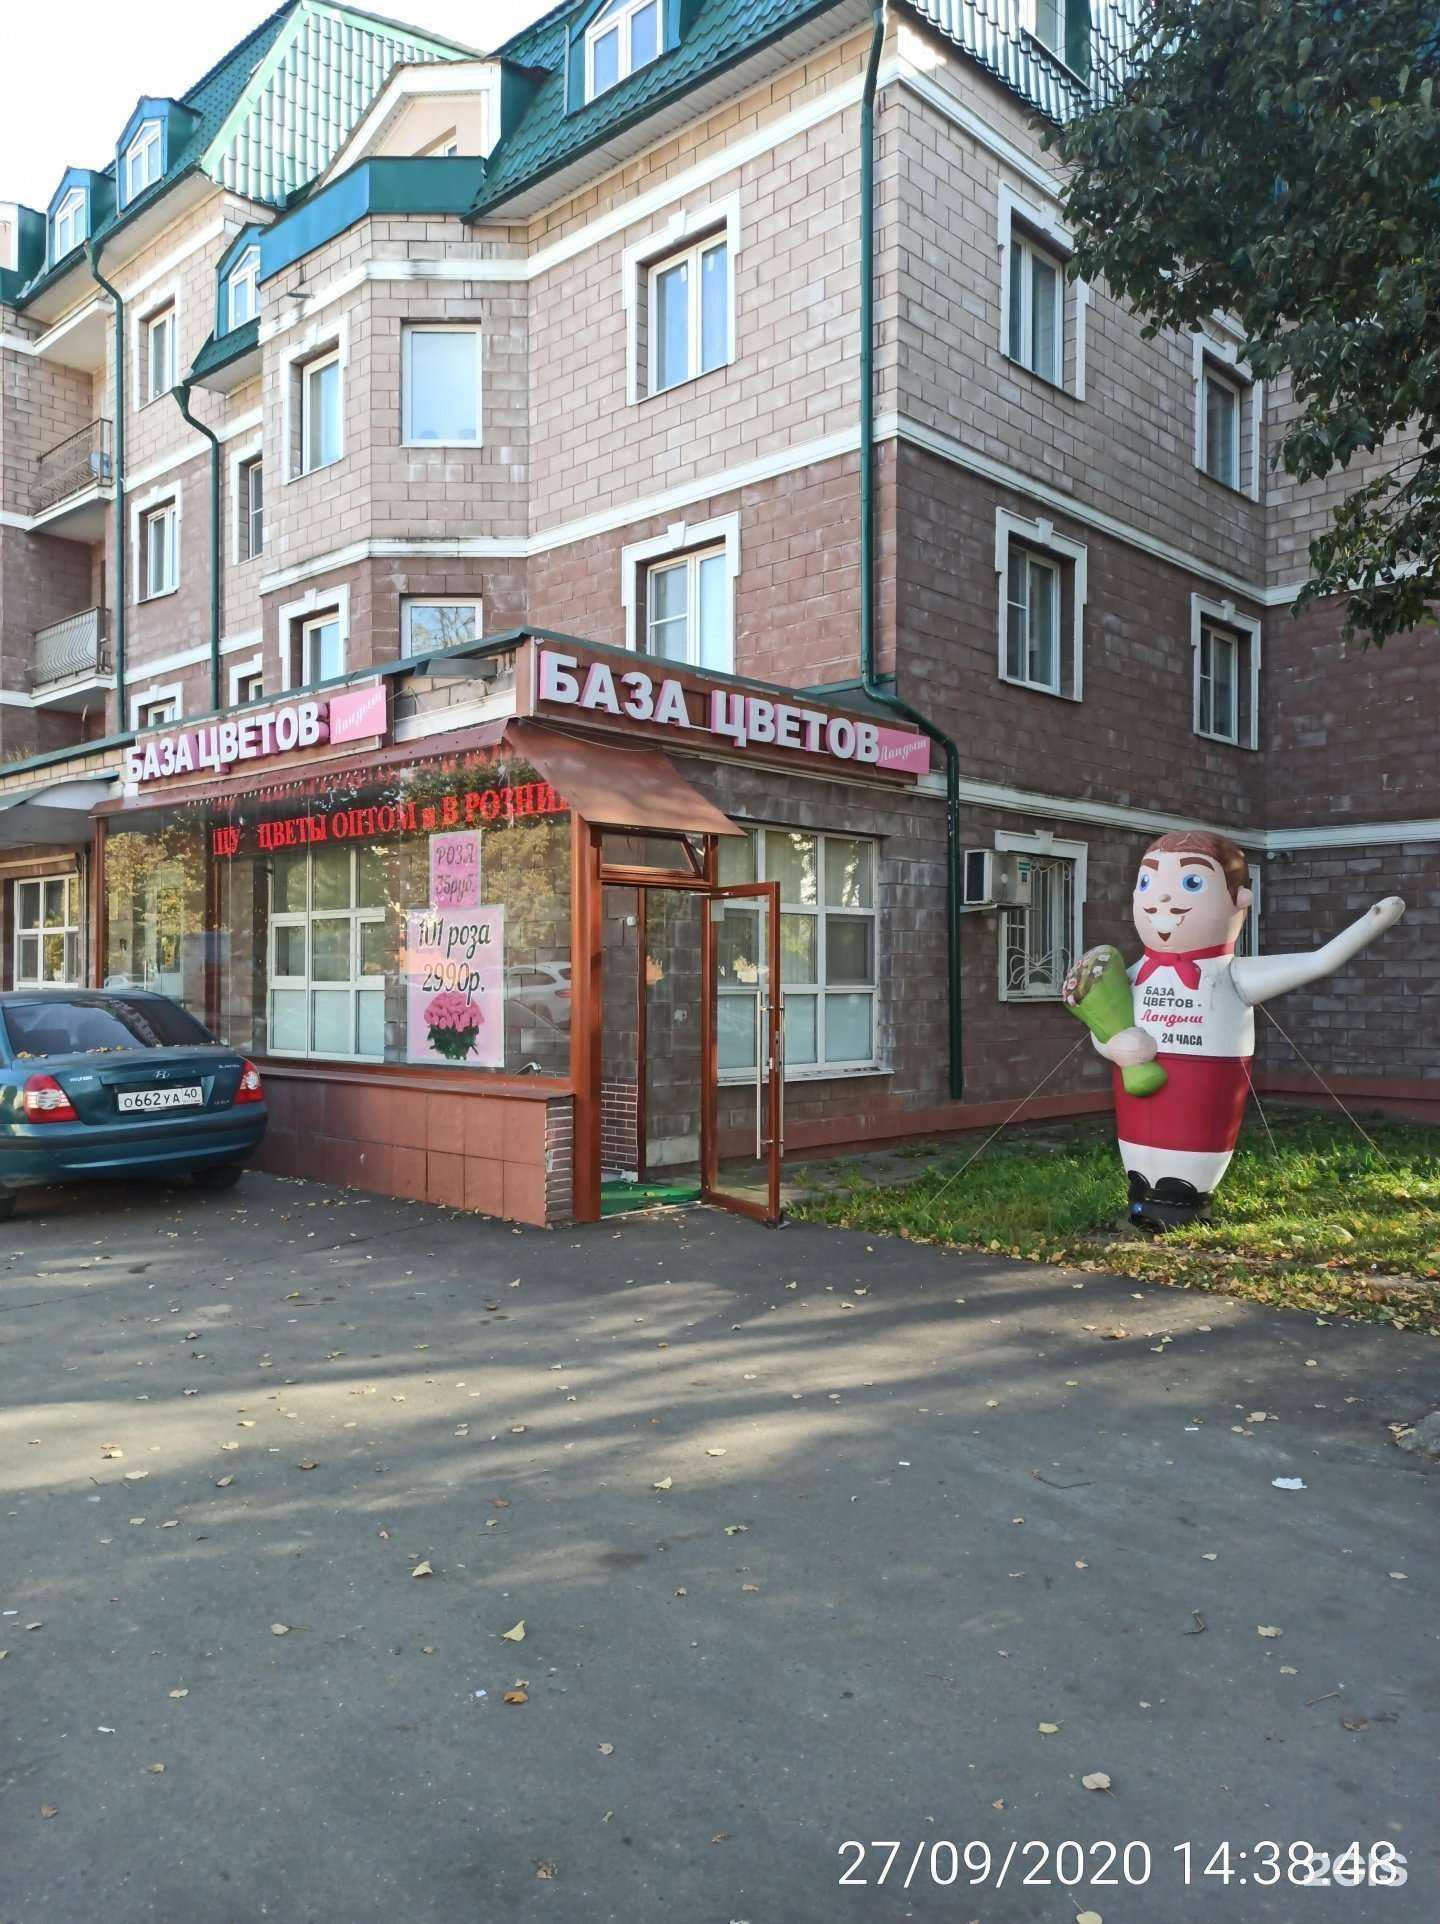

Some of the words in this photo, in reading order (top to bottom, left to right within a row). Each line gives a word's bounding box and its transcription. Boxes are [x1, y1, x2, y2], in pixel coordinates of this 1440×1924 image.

[540, 650, 691, 728] БАЗА
[711, 689, 880, 763] ЦВЕТОВ
[125, 734, 195, 783] БАЗА
[198, 701, 323, 774] ЦВЕТОВ
[257, 815, 327, 849] ЦВЕТЫ
[332, 801, 417, 838] ОПТОМ
[464, 782, 571, 823] РОЗНИ
[447, 923, 492, 960] роза
[422, 962, 485, 1006] 2990р.
[1143, 996, 1194, 1008] ЦВЕТОВ
[1145, 986, 1175, 996] БАЗА
[1141, 1009, 1205, 1027] Ландыш
[1161, 1033, 1174, 1044] 24
[1176, 1034, 1203, 1046] ЧАСА
